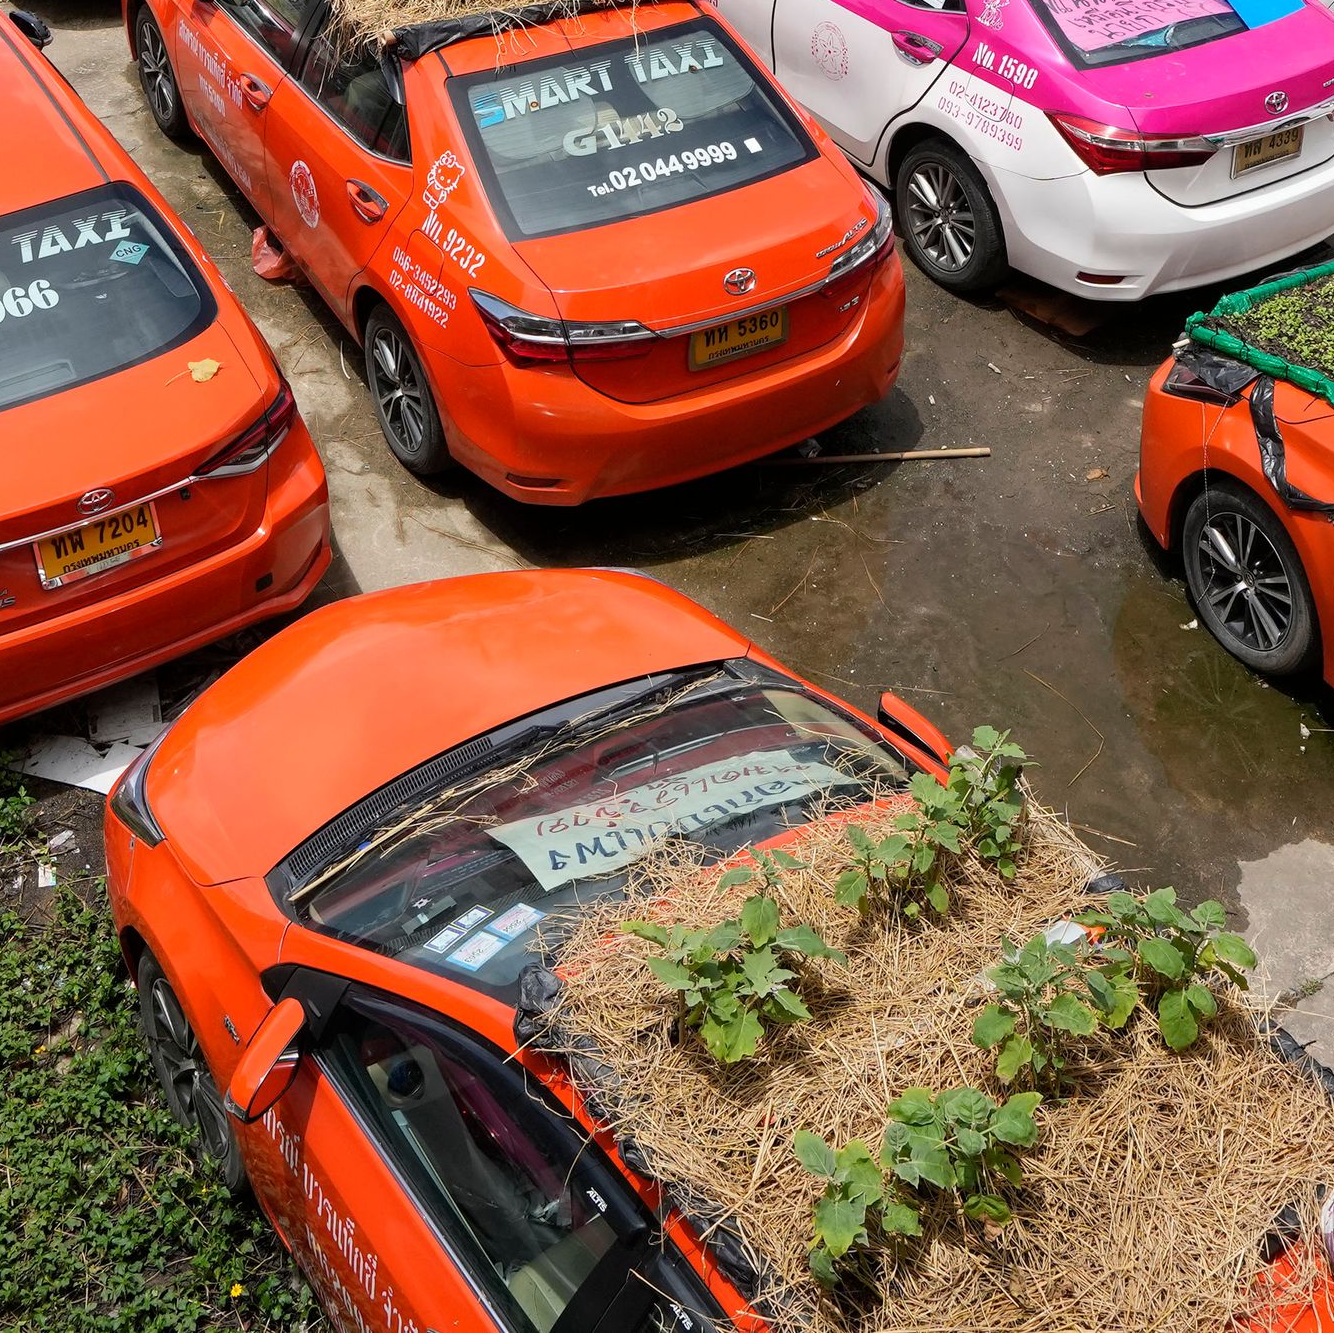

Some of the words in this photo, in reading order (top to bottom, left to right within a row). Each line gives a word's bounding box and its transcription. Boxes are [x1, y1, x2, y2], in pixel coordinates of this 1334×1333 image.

[473, 58, 614, 129] SMART
[623, 37, 725, 83] TAXI
[973, 41, 996, 71] No.
[999, 53, 1039, 90] 1598
[937, 95, 1024, 152] 093-9789399
[949, 79, 1023, 131] 02-4123780
[562, 107, 685, 158] G1442
[1269, 127, 1300, 151] 4339
[11, 208, 134, 265] TAXI
[115, 242, 143, 260] CNG
[421, 209, 441, 243] No.
[442, 229, 486, 279] 9232
[389, 269, 451, 329] 02-8841922
[392, 246, 458, 310] 086-3452293
[738, 311, 780, 336] 5360
[97, 512, 149, 542] 7204
[586, 1187, 608, 1212] ALTIS
[303, 1162, 378, 1300] บวรแท็กซี่
[671, 1303, 693, 1331] ALTIS
